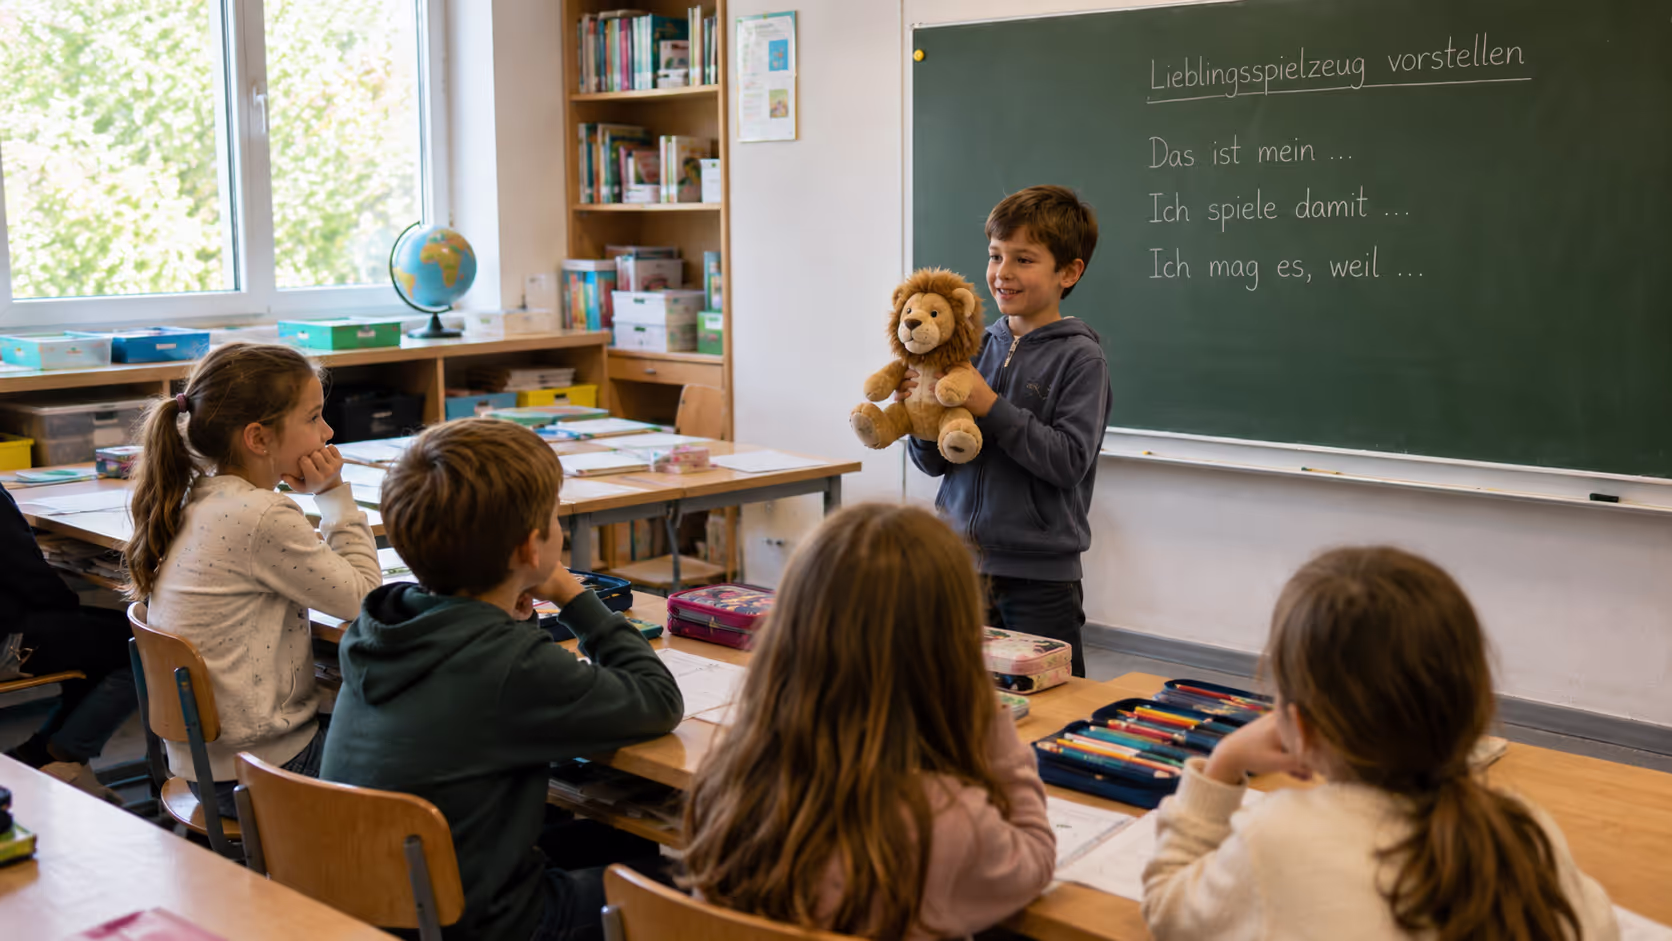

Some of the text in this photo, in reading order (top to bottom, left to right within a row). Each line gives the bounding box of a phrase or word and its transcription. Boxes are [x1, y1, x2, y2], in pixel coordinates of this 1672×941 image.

[1150, 32, 1525, 98] Lieblingsspielzeug vorstellen
[1149, 136, 1195, 169] Das
[1213, 135, 1241, 165] ist
[1258, 138, 1316, 163] mein
[1149, 192, 1190, 224] Ich
[1208, 188, 1278, 232] spiele
[1295, 185, 1368, 218] damit
[1149, 248, 1191, 279] Ich
[1209, 258, 1259, 291] mag
[1277, 257, 1312, 284] es,
[1330, 246, 1380, 278] weil
